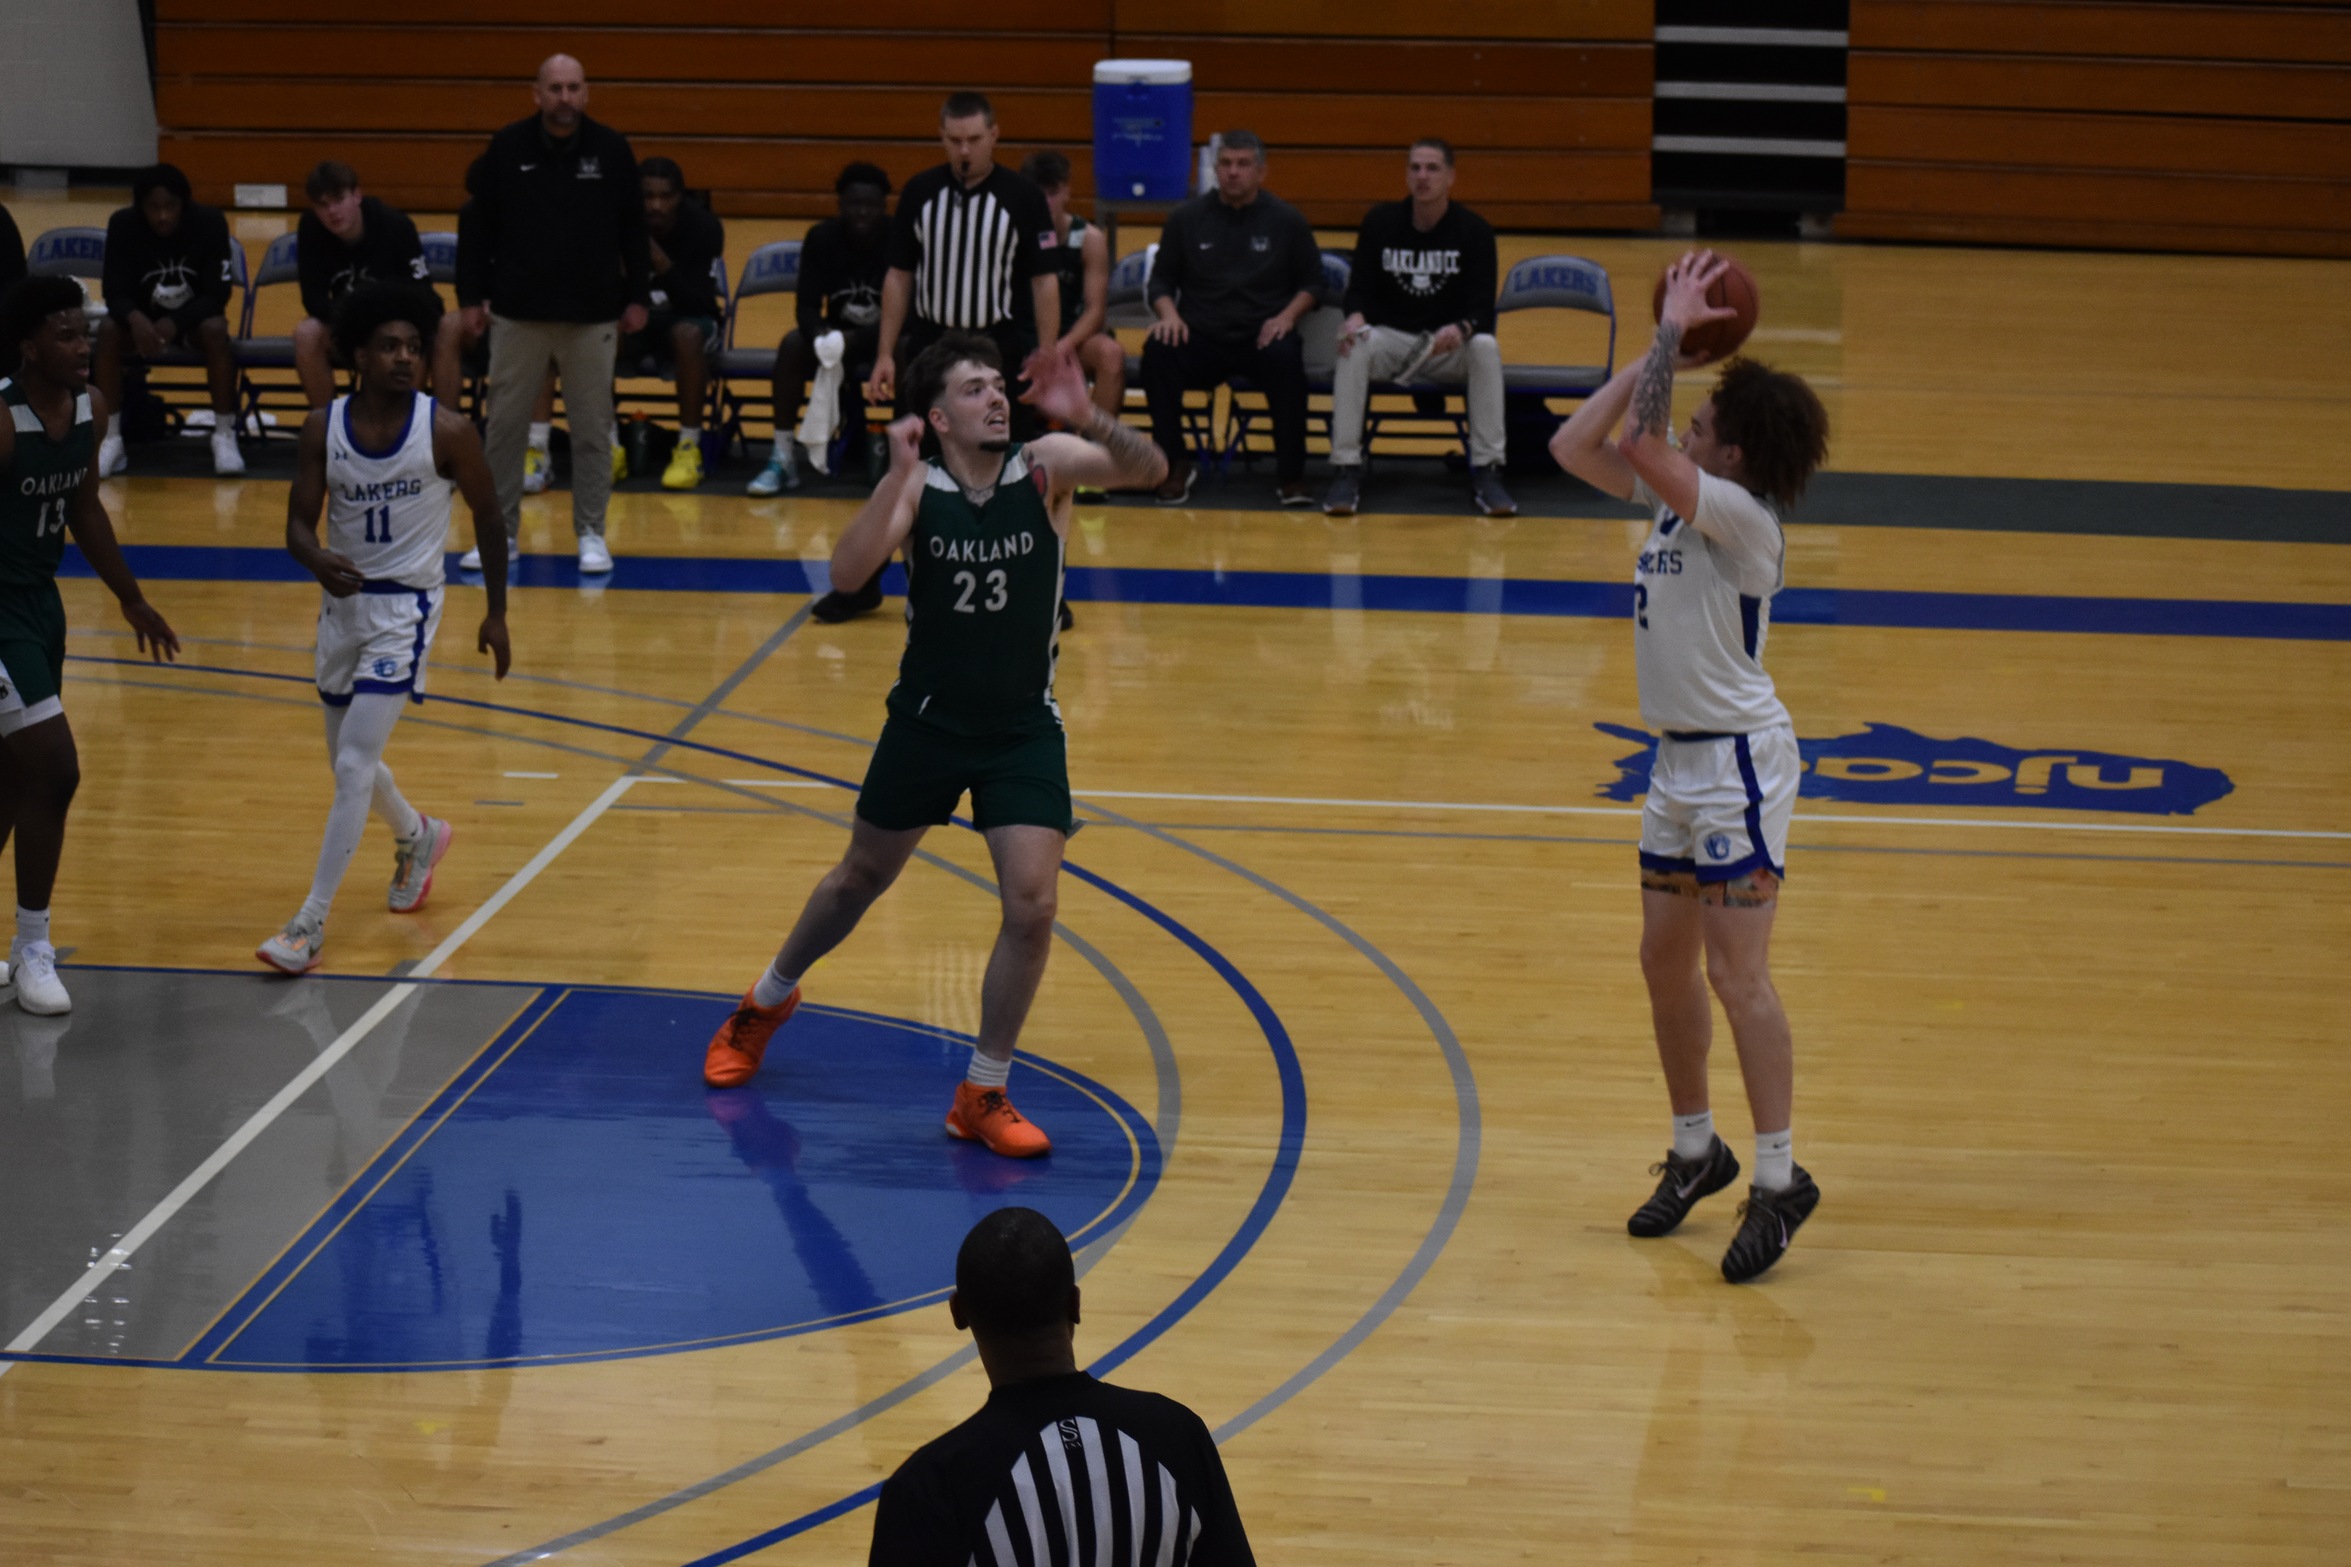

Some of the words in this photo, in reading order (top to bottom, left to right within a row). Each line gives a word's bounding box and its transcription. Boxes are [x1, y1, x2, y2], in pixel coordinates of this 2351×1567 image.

[37, 237, 104, 261] LAKER
[1511, 266, 1598, 294] LAKERS
[341, 479, 422, 502] LAKERS
[36, 497, 66, 538] 13
[364, 505, 393, 544] 11
[929, 531, 1034, 564] OAKLAND
[952, 568, 1009, 614] 23
[1799, 755, 2165, 795] njca
